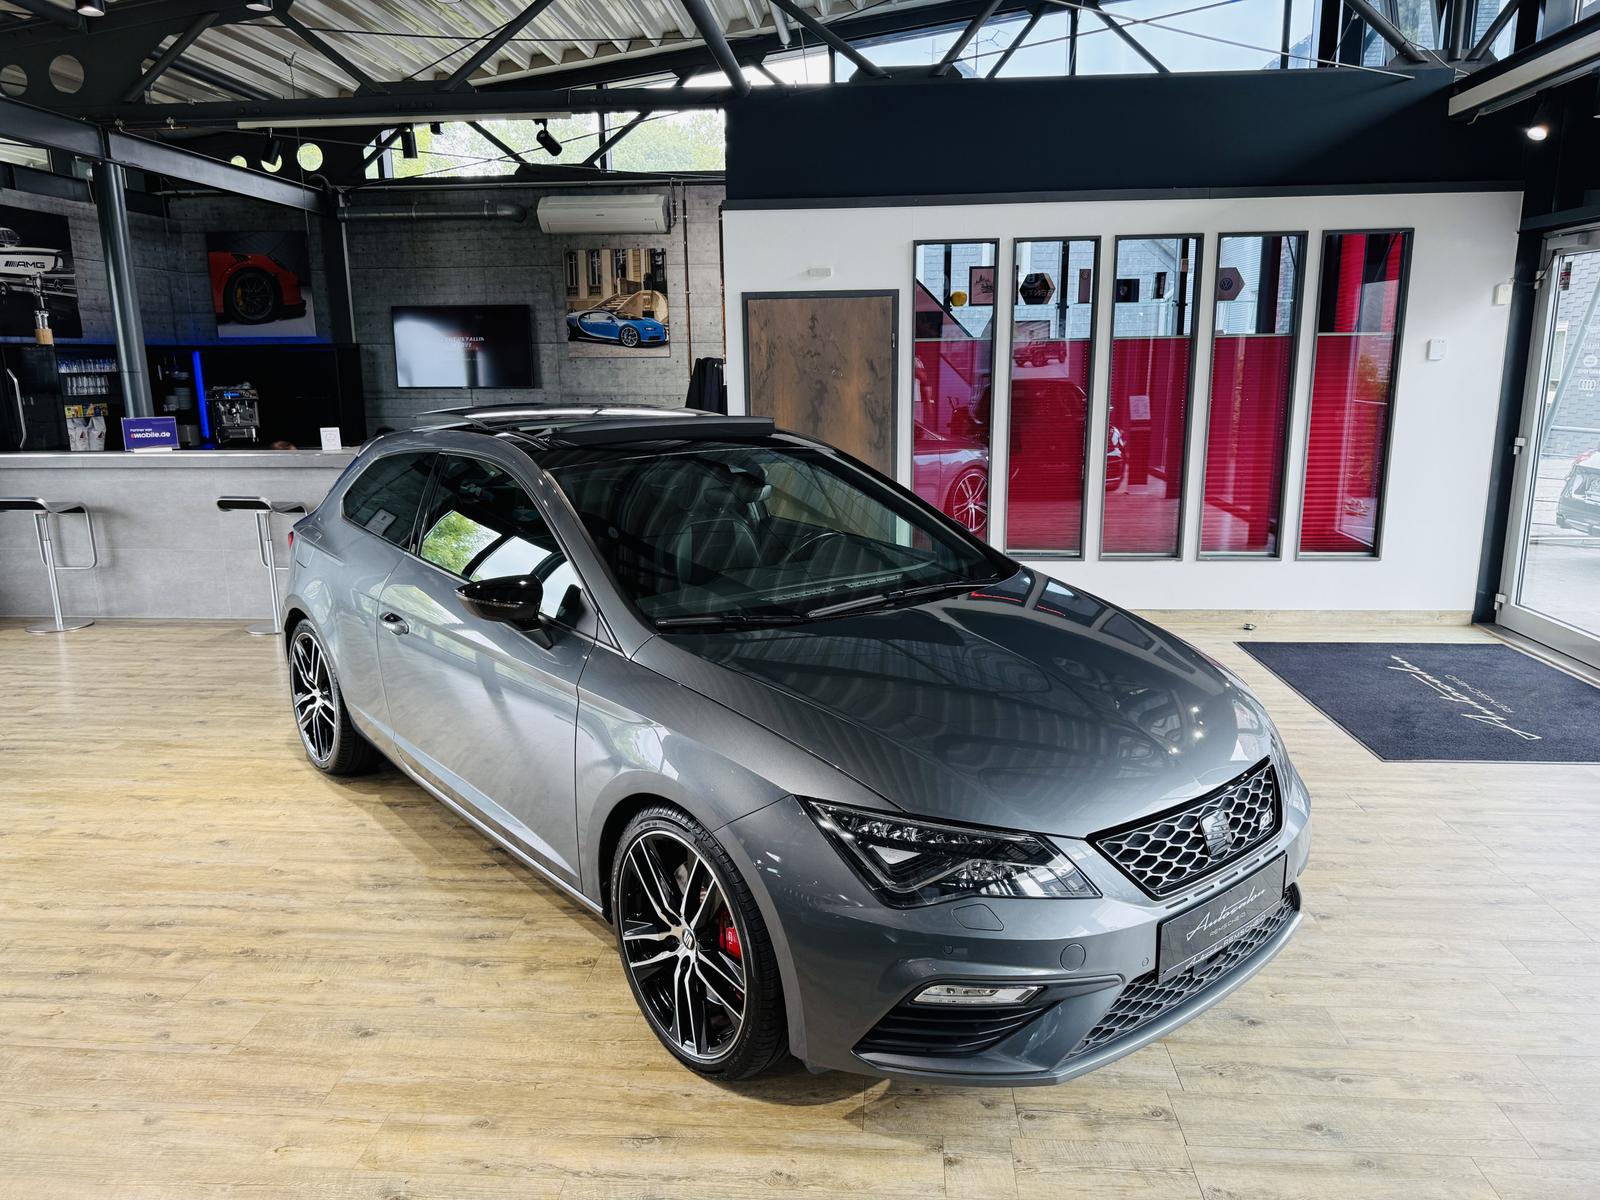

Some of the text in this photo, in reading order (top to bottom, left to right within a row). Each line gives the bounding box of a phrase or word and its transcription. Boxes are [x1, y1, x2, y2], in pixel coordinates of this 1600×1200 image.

[17, 261, 46, 269] AMG
[131, 431, 170, 439] mobile.de
[1223, 914, 1266, 946] REMSCHEID
